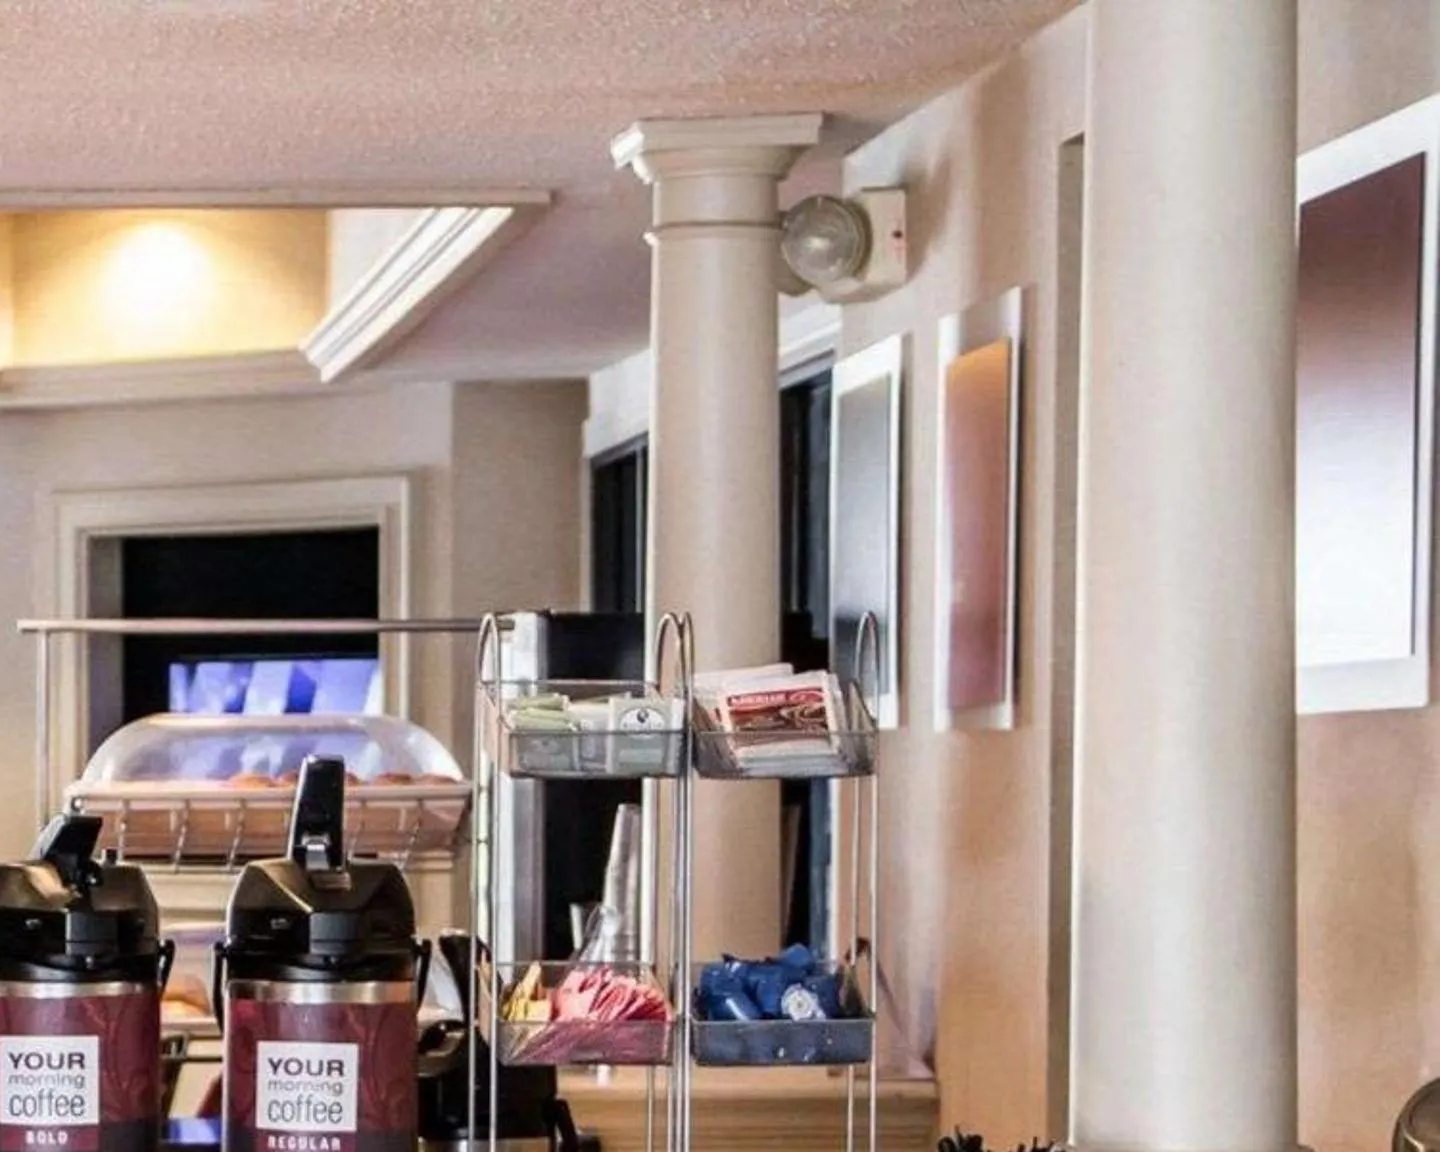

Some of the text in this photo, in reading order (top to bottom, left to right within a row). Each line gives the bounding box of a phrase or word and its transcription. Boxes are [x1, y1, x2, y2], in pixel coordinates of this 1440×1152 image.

[8, 1052, 85, 1070] YOUR
[267, 1057, 344, 1076] YOUR
[8, 1074, 85, 1089] morning
[268, 1080, 343, 1097] morning
[9, 1088, 85, 1117] coffee
[268, 1094, 343, 1124] coffee
[26, 1130, 68, 1145] BOLD
[267, 1135, 341, 1151] REGULAR
